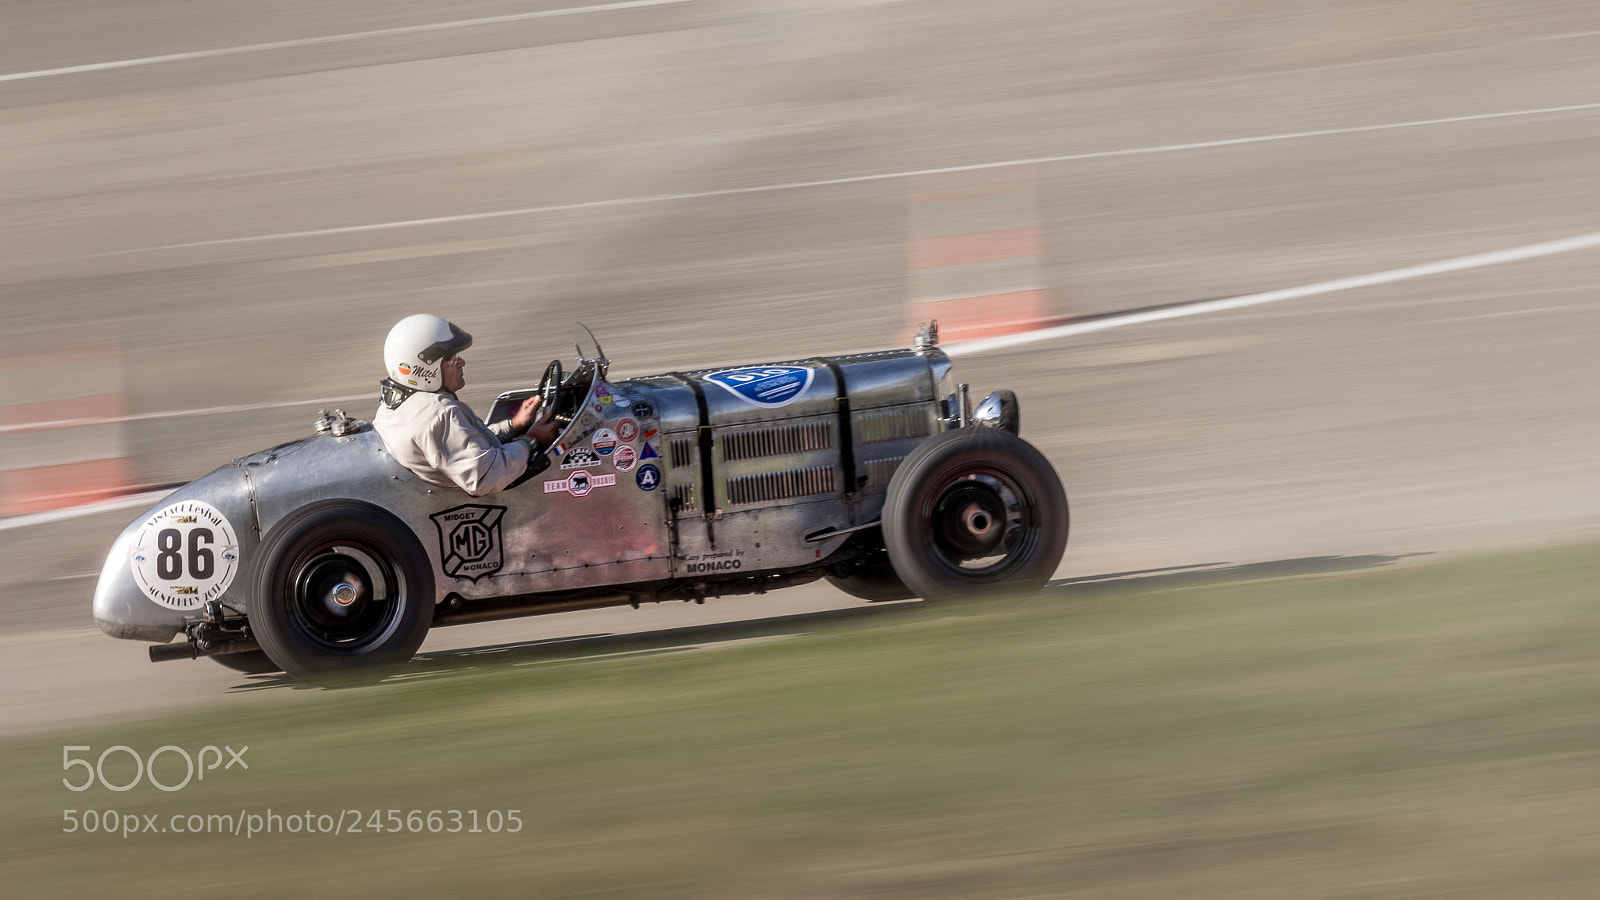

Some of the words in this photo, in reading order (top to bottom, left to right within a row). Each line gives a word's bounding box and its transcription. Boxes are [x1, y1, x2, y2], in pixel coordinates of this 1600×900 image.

[412, 365, 438, 378] Mitch
[546, 481, 567, 491] TEAM
[444, 512, 475, 522] MIDGET
[455, 525, 487, 557] MG
[157, 527, 214, 580] 86
[463, 561, 499, 572] MONACO
[687, 559, 741, 573] MONACO
